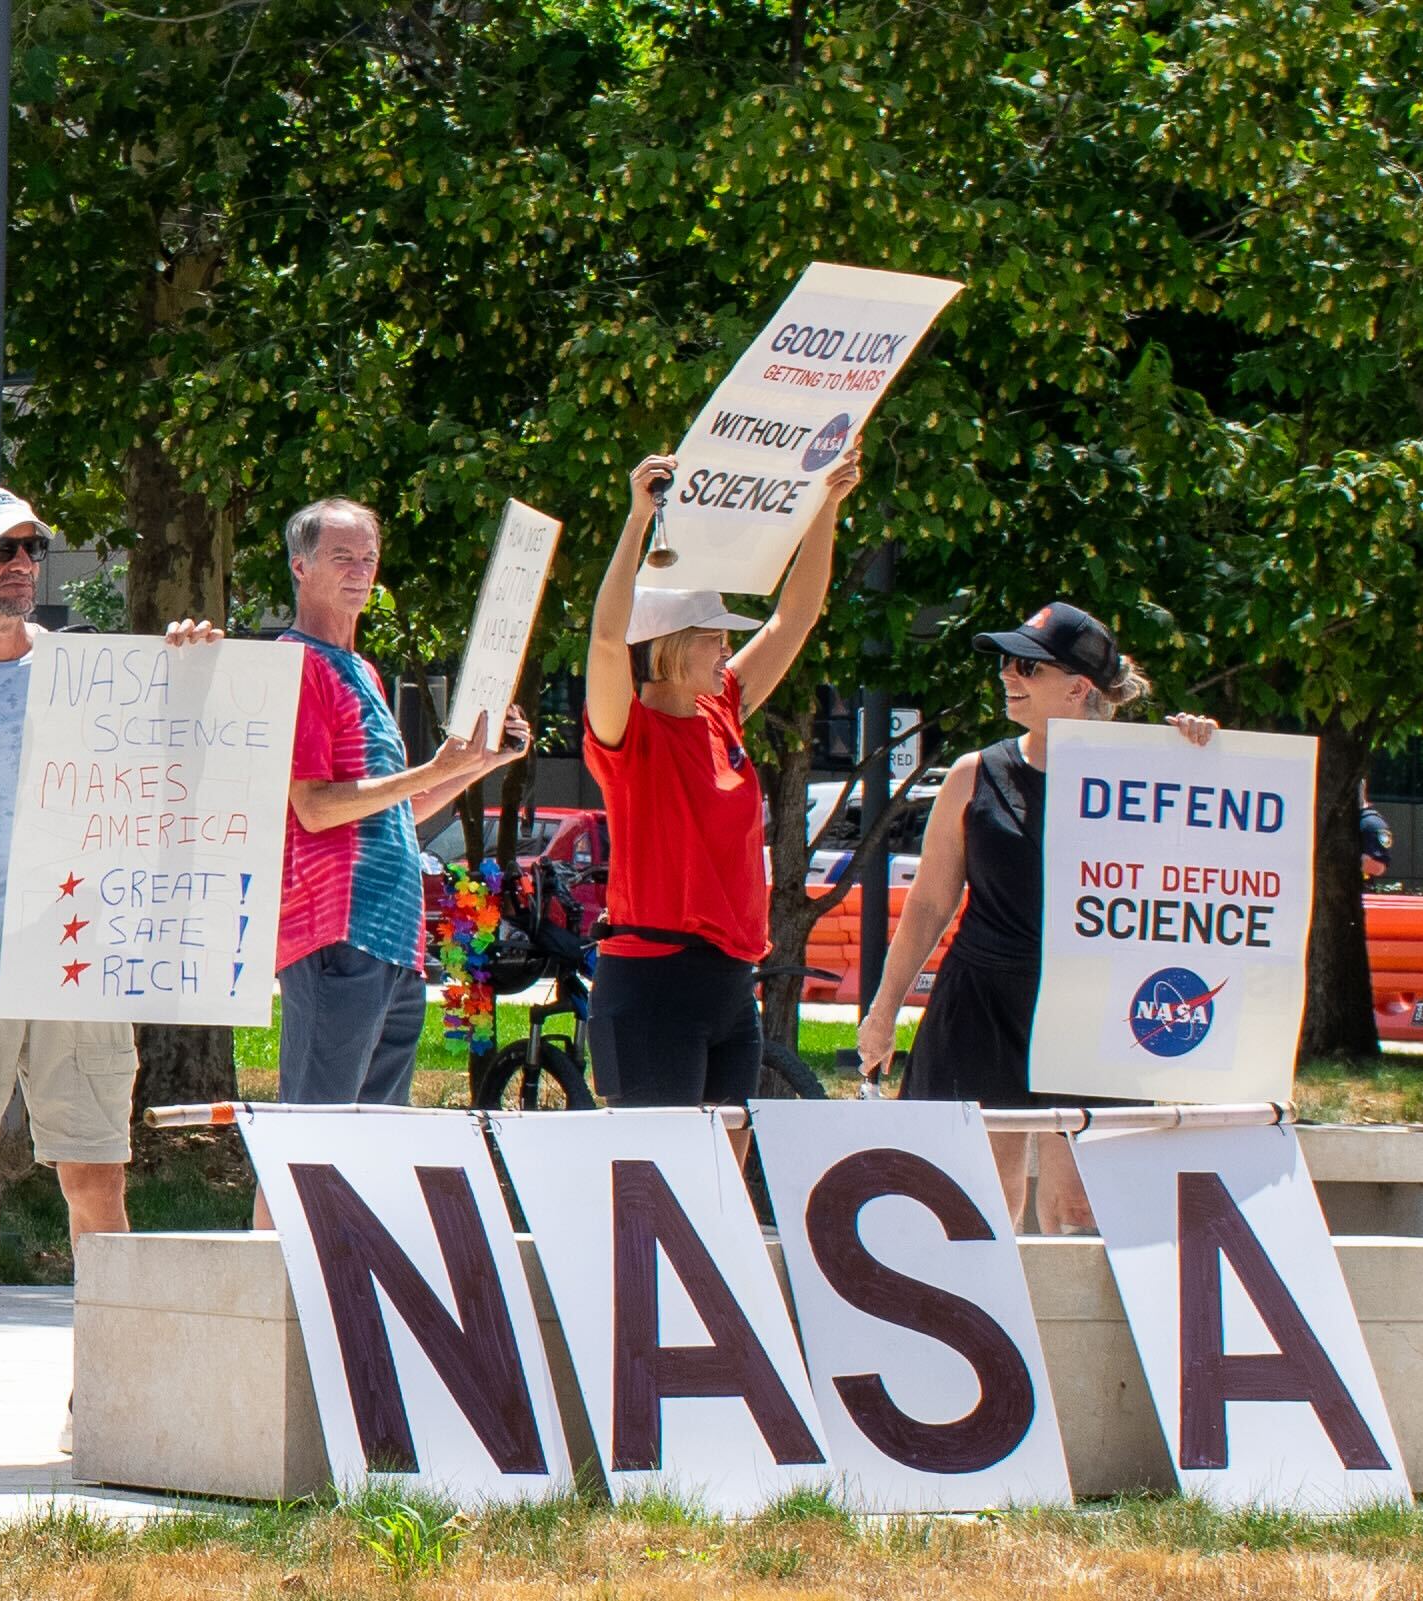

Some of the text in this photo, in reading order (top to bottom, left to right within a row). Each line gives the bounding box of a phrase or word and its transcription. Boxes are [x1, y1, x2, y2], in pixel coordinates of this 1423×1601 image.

[770, 323, 908, 365] GOOD LUCK
[763, 364, 887, 392] GETTING TO MARS
[709, 410, 843, 452] WITHOUT NASA
[680, 468, 811, 515] SCIENCE
[49, 646, 170, 707] NASA
[93, 713, 270, 753] SCIENCE
[41, 761, 188, 809] MAKES
[1079, 777, 1285, 834] DEFEND
[81, 813, 249, 851] AMERICA
[99, 867, 227, 908] GREAT
[1081, 860, 1281, 898] NOT DEFUND
[108, 915, 205, 948] SAFE
[1075, 894, 1272, 948] SCIENCE
[102, 954, 198, 997] RICH
[1134, 1001, 1210, 1027] NASA
